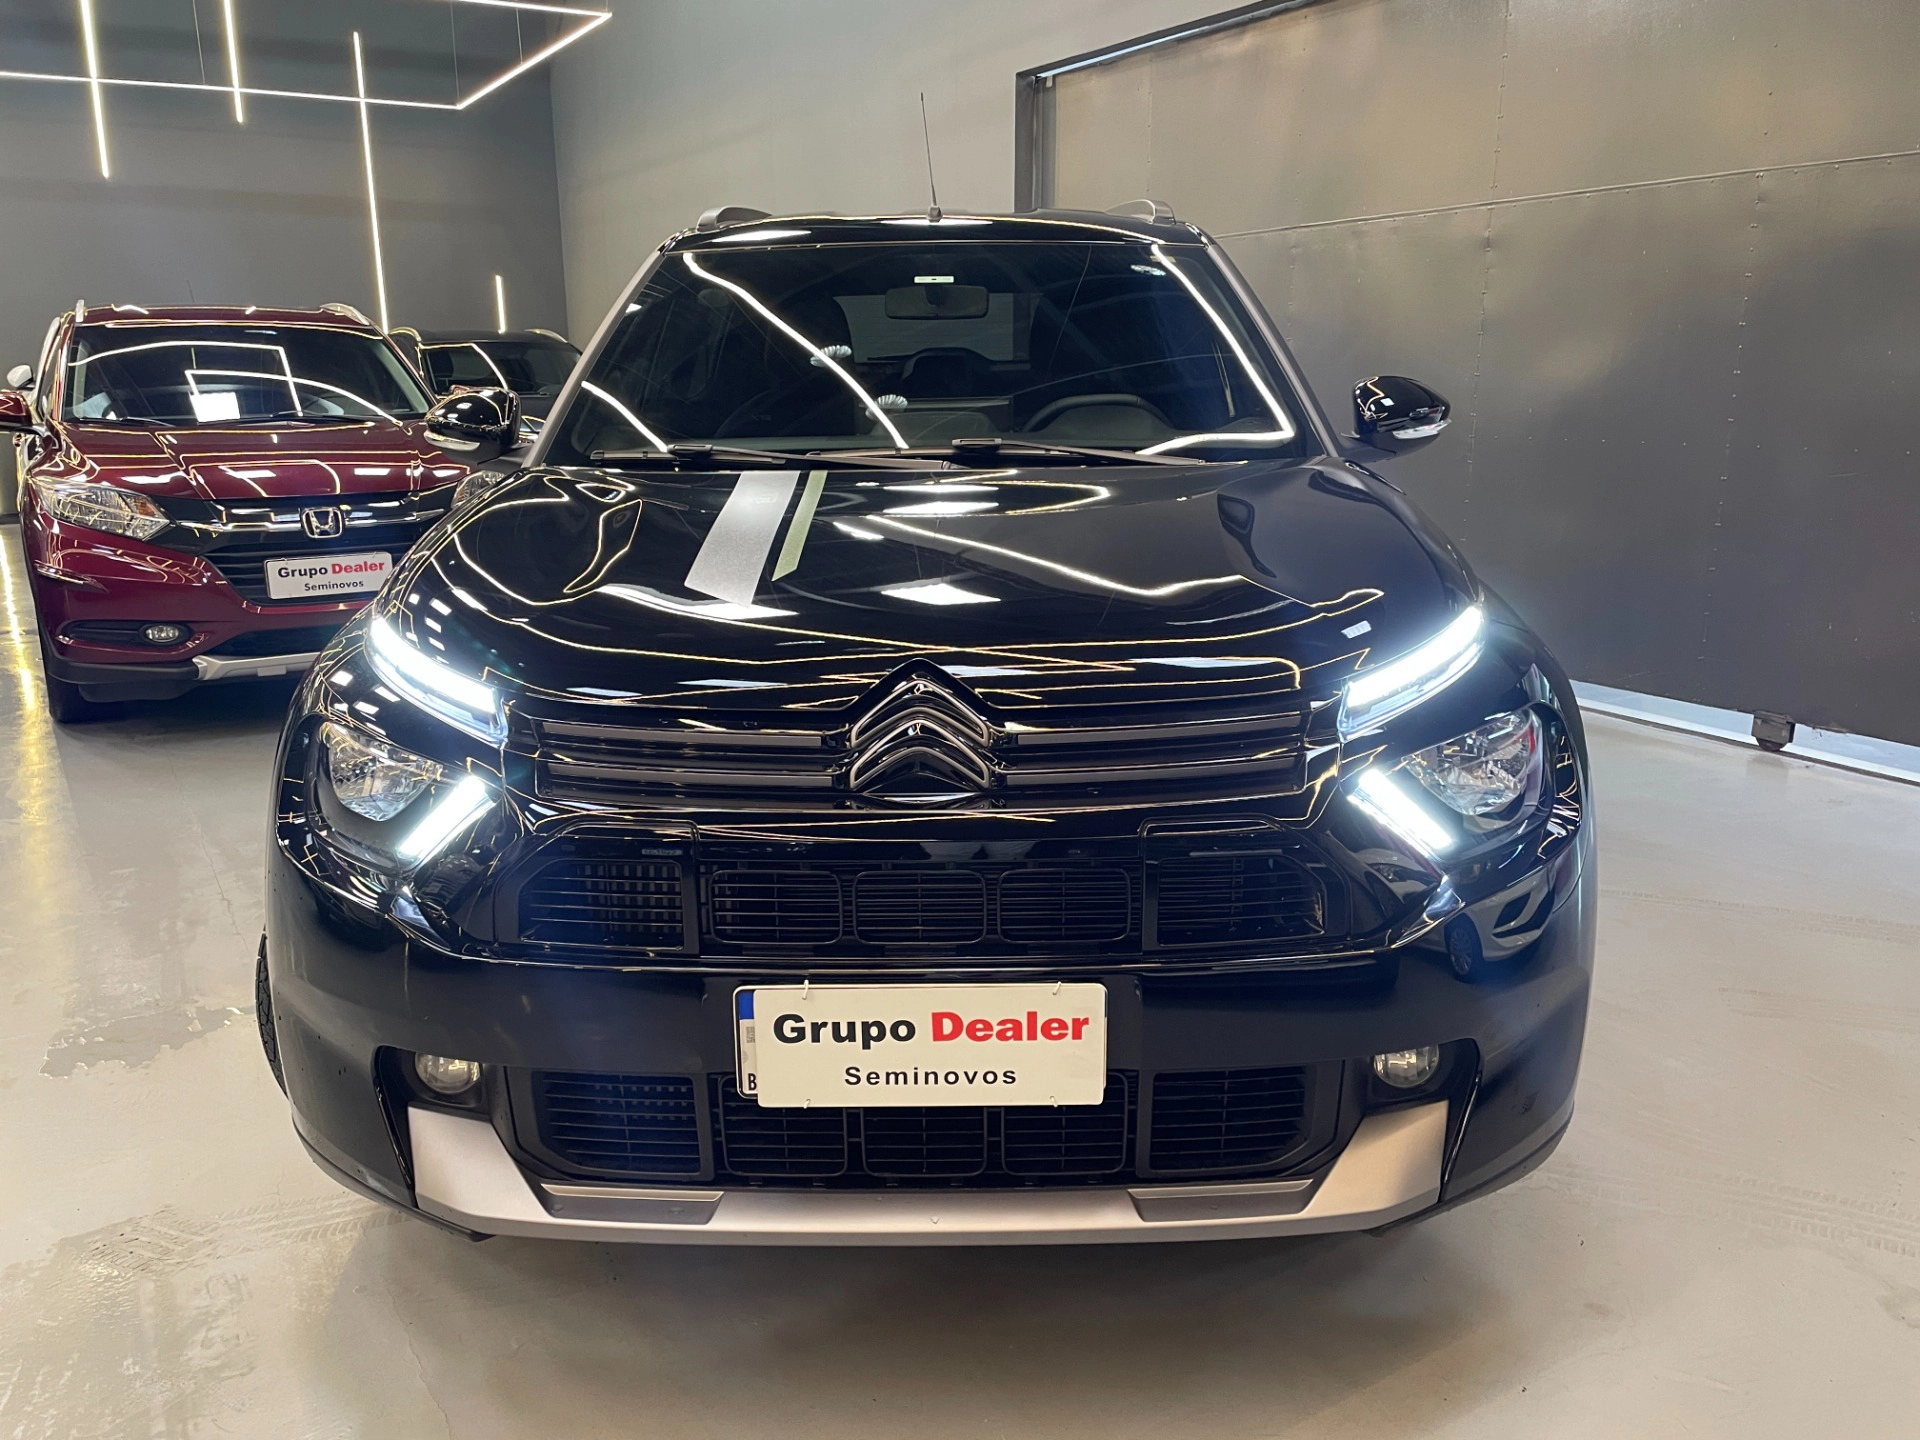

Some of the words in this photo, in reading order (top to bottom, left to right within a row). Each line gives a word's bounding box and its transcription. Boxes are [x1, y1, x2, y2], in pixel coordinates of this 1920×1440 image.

[277, 566, 329, 578] Grupo
[331, 561, 385, 575] Dealer
[304, 580, 364, 592] Seminovos
[773, 1013, 916, 1050] Grupo
[931, 1010, 1090, 1043] Dealer
[844, 1066, 1017, 1086] Seminovos
